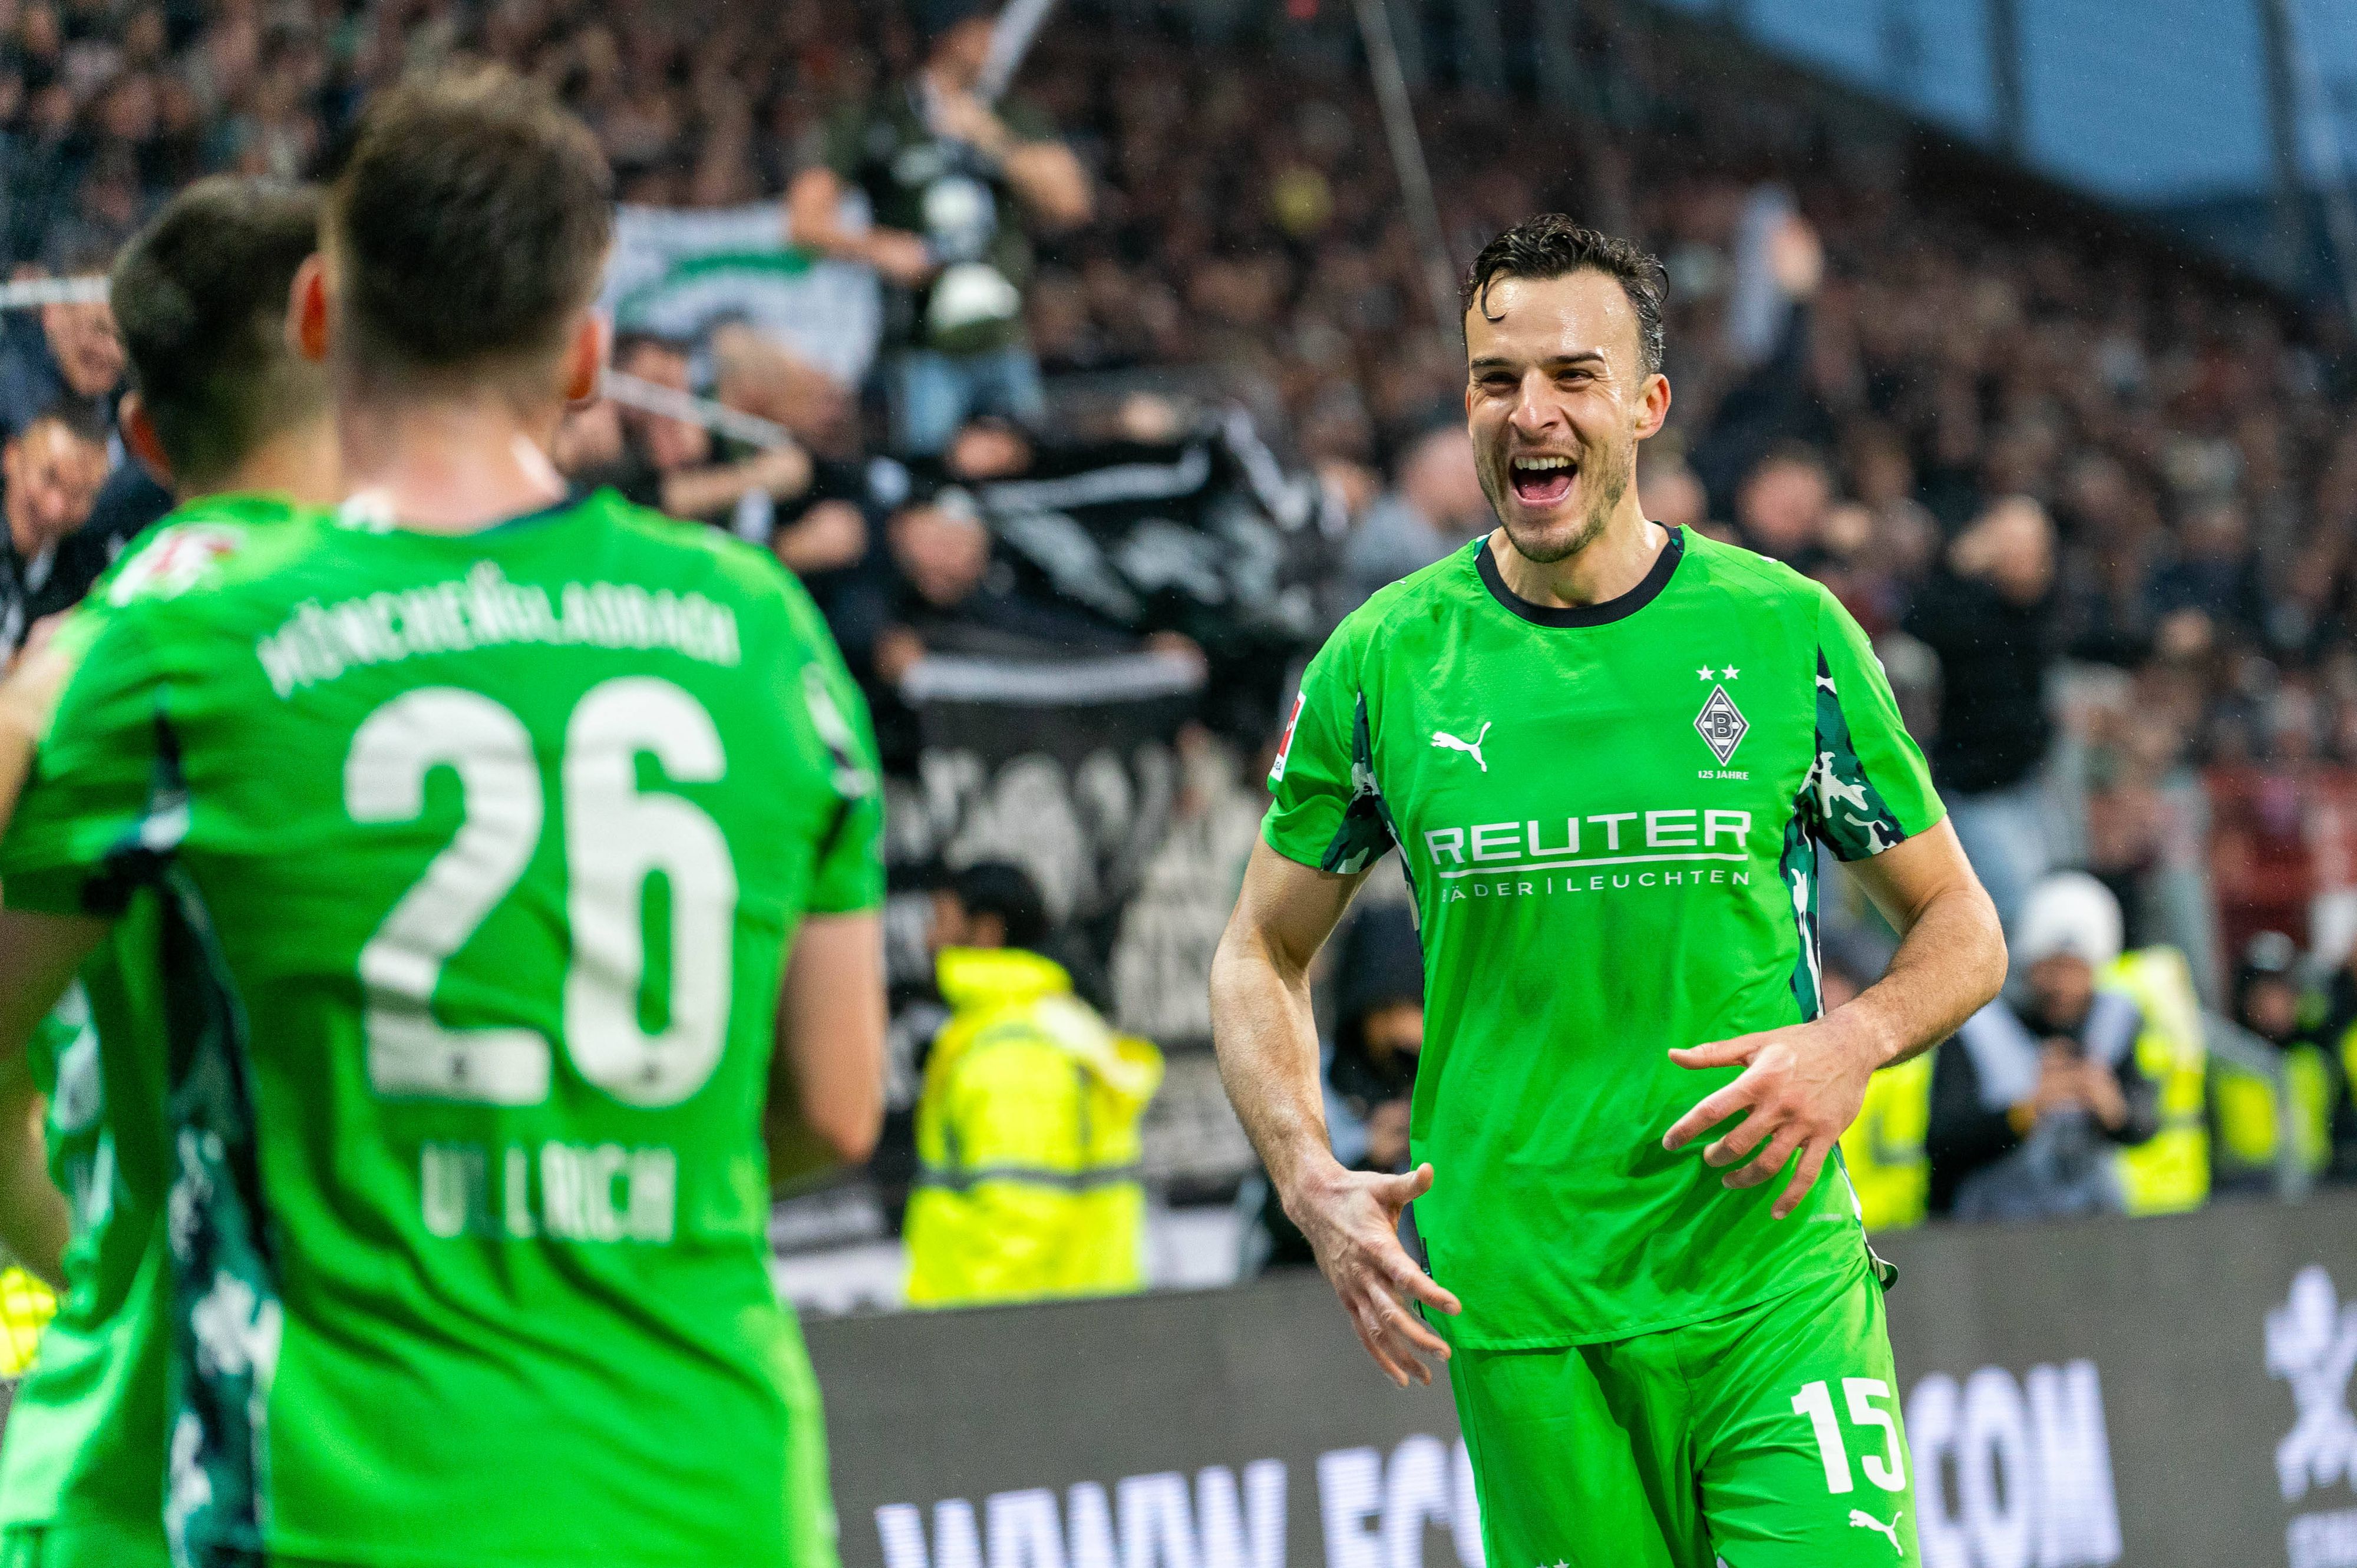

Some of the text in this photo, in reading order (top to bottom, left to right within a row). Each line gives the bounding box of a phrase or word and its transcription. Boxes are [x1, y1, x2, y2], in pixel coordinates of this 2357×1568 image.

[1698, 770, 1749, 781] 125 JAHRE
[1424, 809, 1752, 866] REUTER
[344, 676, 740, 1108] 26
[1566, 870, 1749, 892] LEUCHTEN
[1790, 1377, 1906, 1494] 15
